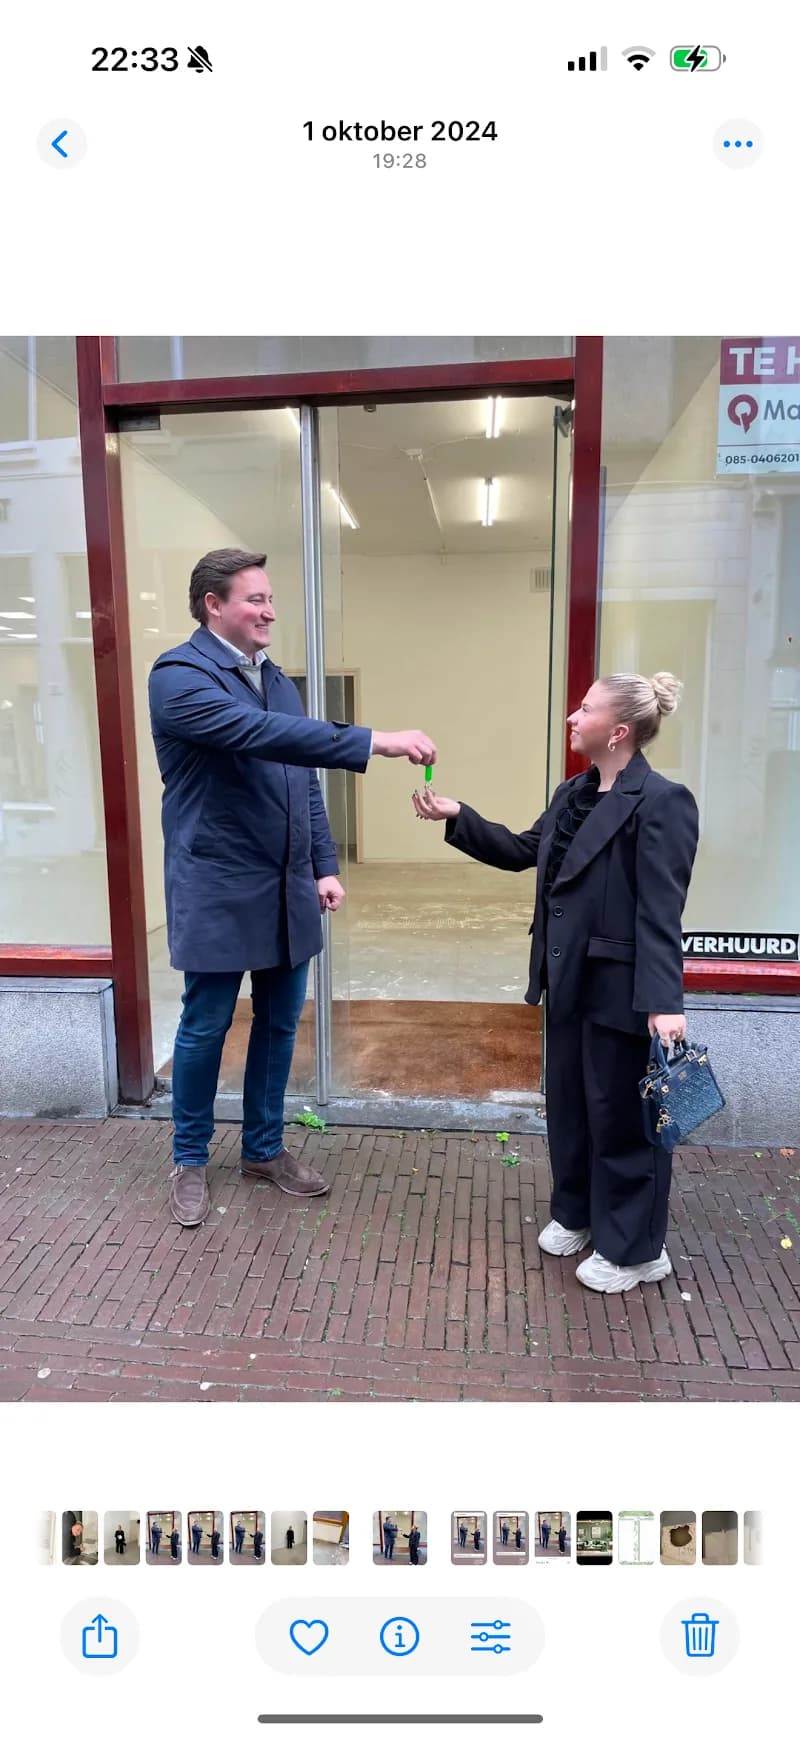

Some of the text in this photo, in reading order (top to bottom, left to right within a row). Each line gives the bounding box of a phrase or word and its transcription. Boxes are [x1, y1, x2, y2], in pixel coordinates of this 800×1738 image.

[729, 347, 776, 376] TE
[725, 453, 799, 465] 085-0406201
[681, 936, 797, 955] VERHUURD
